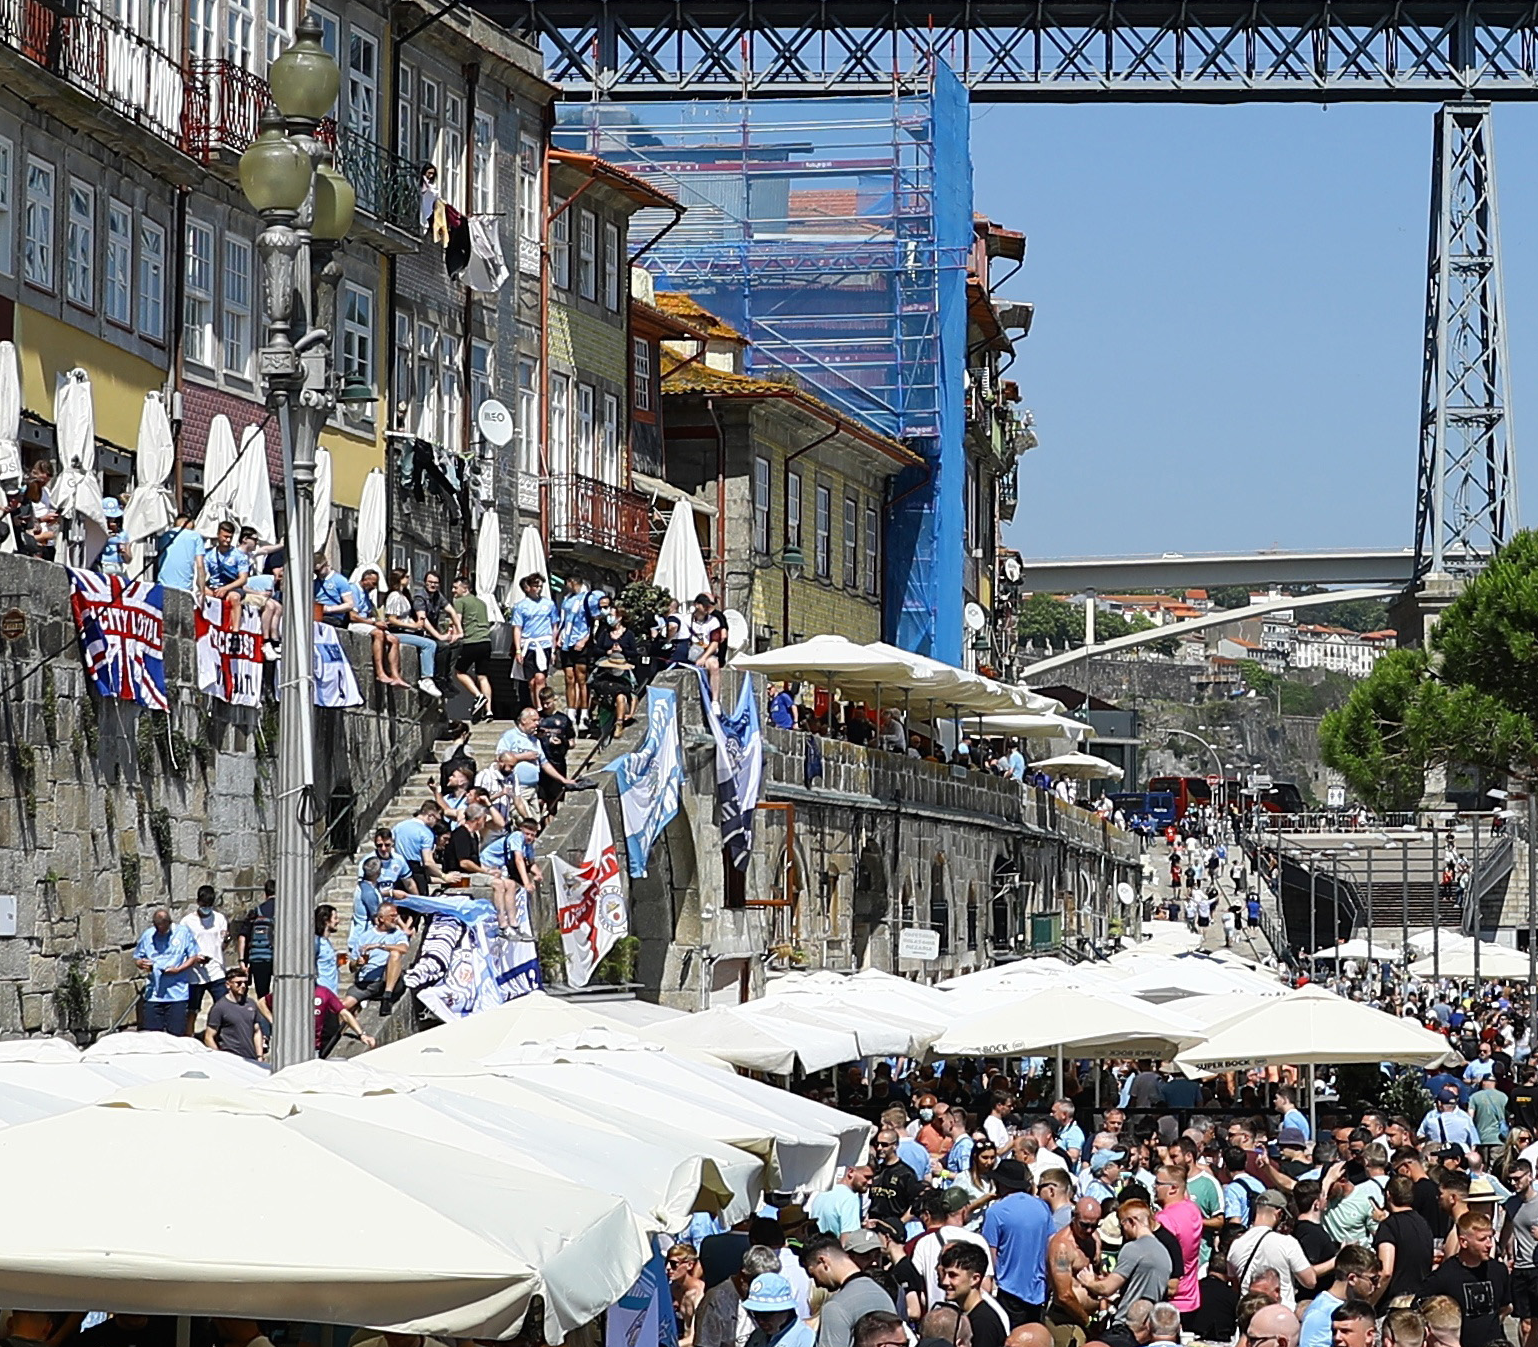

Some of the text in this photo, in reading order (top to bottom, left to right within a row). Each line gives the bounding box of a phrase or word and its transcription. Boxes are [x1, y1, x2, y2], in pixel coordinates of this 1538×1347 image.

[99, 606, 128, 634] CITY
[1196, 1059, 1250, 1071] SUPER BOCK
